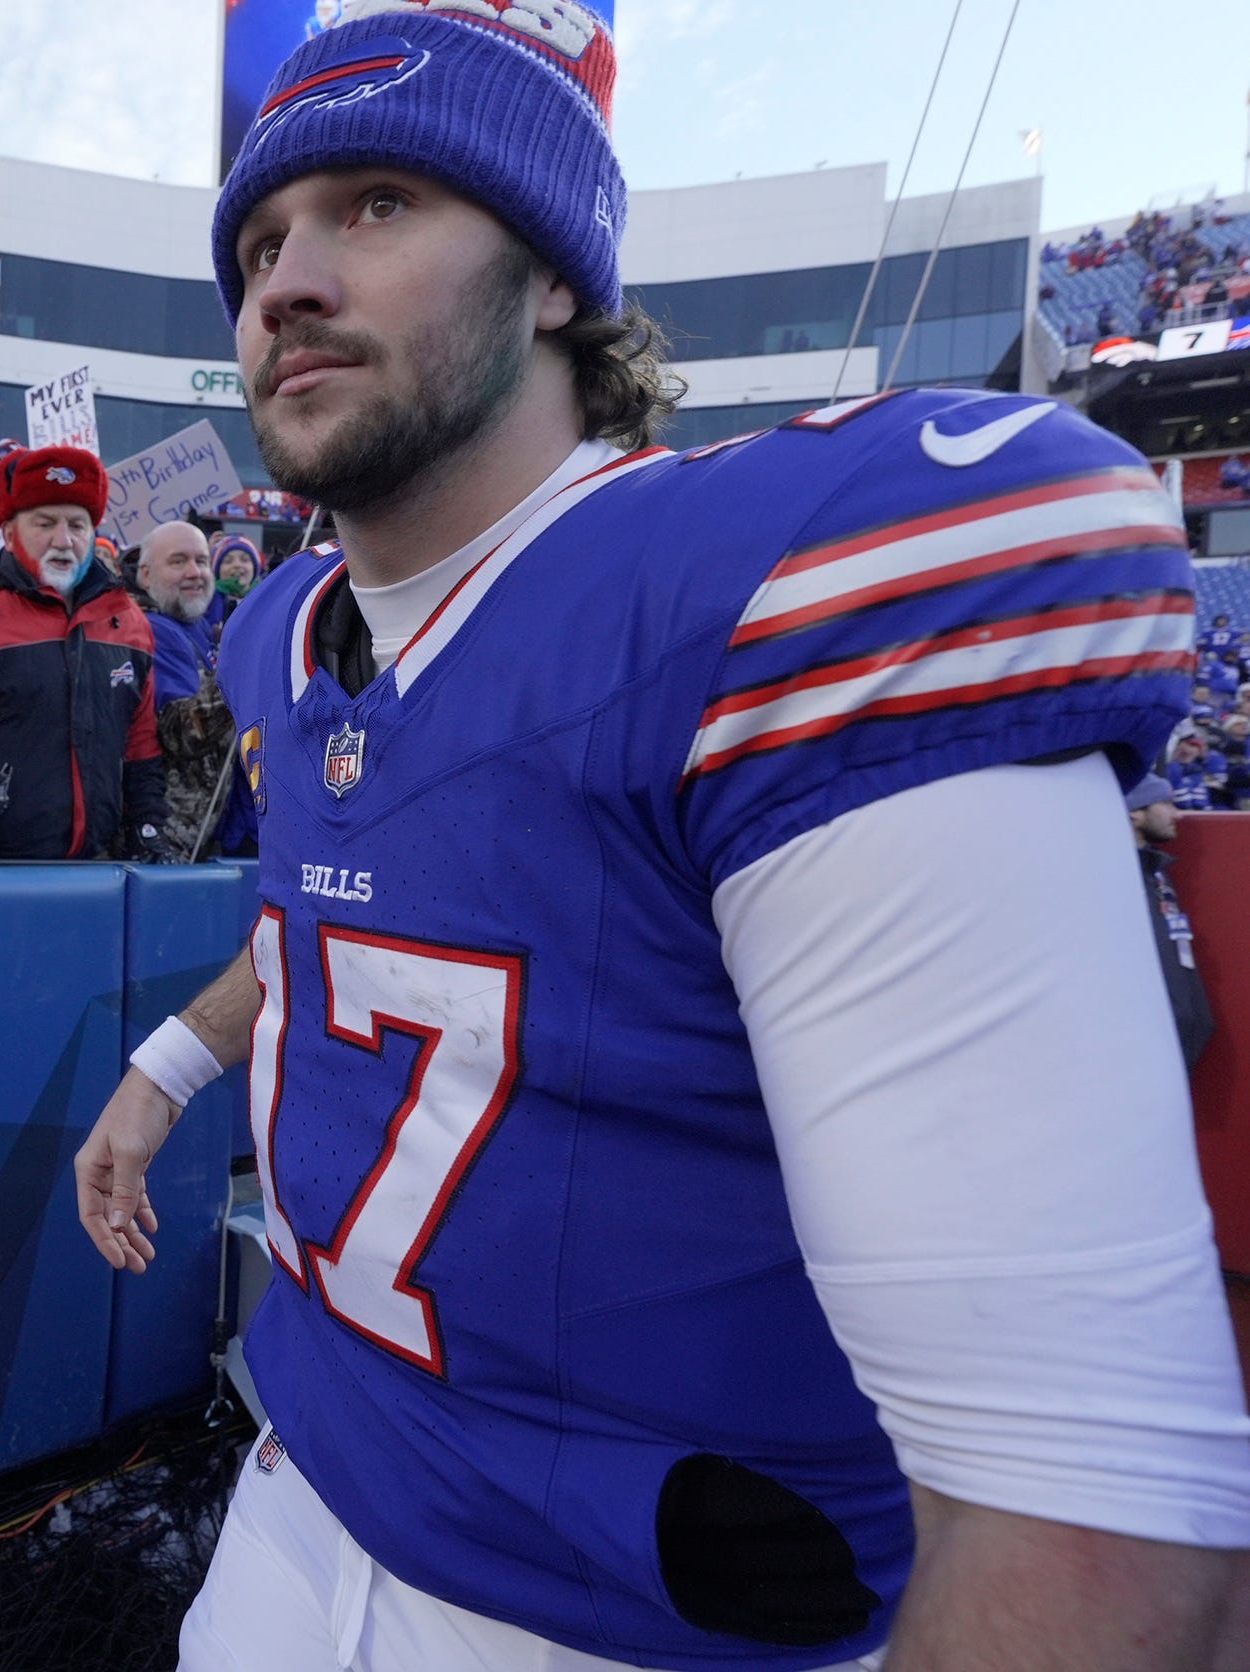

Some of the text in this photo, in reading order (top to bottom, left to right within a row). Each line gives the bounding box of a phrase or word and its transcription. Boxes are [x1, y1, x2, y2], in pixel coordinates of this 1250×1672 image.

[30, 365, 89, 408] MY FIRST
[41, 388, 85, 421] EVER
[52, 427, 95, 448] AME
[107, 441, 220, 512] 0th Birthday
[147, 483, 230, 525] Game
[327, 756, 354, 784] NFL
[301, 863, 373, 903] BILLS
[249, 901, 529, 1386] 17
